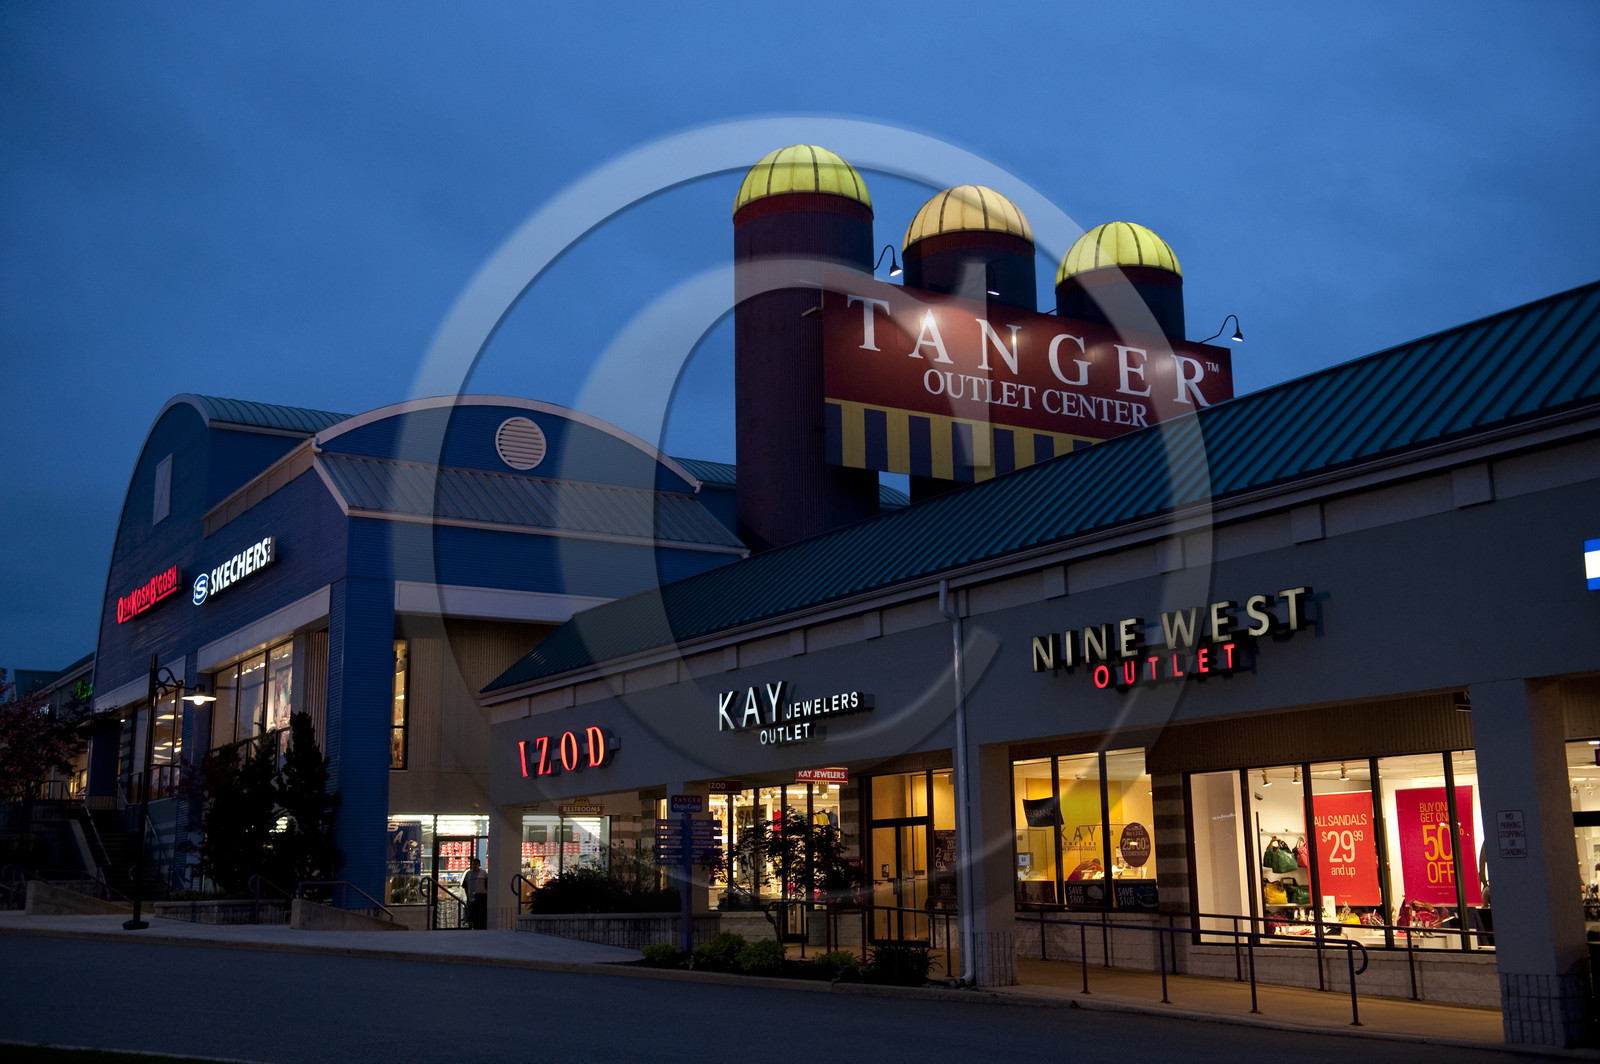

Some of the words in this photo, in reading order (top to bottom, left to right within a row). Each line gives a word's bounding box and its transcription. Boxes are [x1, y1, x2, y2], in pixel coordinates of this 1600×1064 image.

[923, 369, 1036, 410] OUTLET
[1041, 388, 1149, 428] CENTER
[210, 537, 268, 596] SKECHERS
[1032, 617, 1140, 672] NINE
[1160, 587, 1311, 650] WEST
[1093, 642, 1236, 690] OUTLET
[719, 680, 786, 731] KAY
[786, 691, 860, 720] JEWELERS
[760, 722, 811, 746] OUTLET
[518, 726, 605, 778] IZOD
[798, 770, 812, 779] KAY
[813, 769, 846, 780] JEWELERS
[563, 805, 601, 813] RESTROOMS
[1419, 802, 1435, 813] BUY
[1435, 801, 1450, 812] ON
[738, 808, 766, 824] SAE
[1314, 814, 1328, 827] ALL
[1327, 812, 1368, 827] SANDALS
[1420, 812, 1434, 824] GET
[1436, 811, 1450, 823] ON
[1505, 812, 1514, 820] NO
[1500, 821, 1521, 829] PARKING
[1061, 826, 1097, 842] KAY
[1499, 830, 1524, 839] STOPPING
[1509, 839, 1516, 847] OR
[1501, 848, 1526, 856] STANDING
[1330, 864, 1346, 876] and
[1345, 865, 1356, 878] up
[1426, 861, 1456, 884] OFF
[1068, 886, 1083, 895] SAVE
[1117, 887, 1134, 896] SAVE
